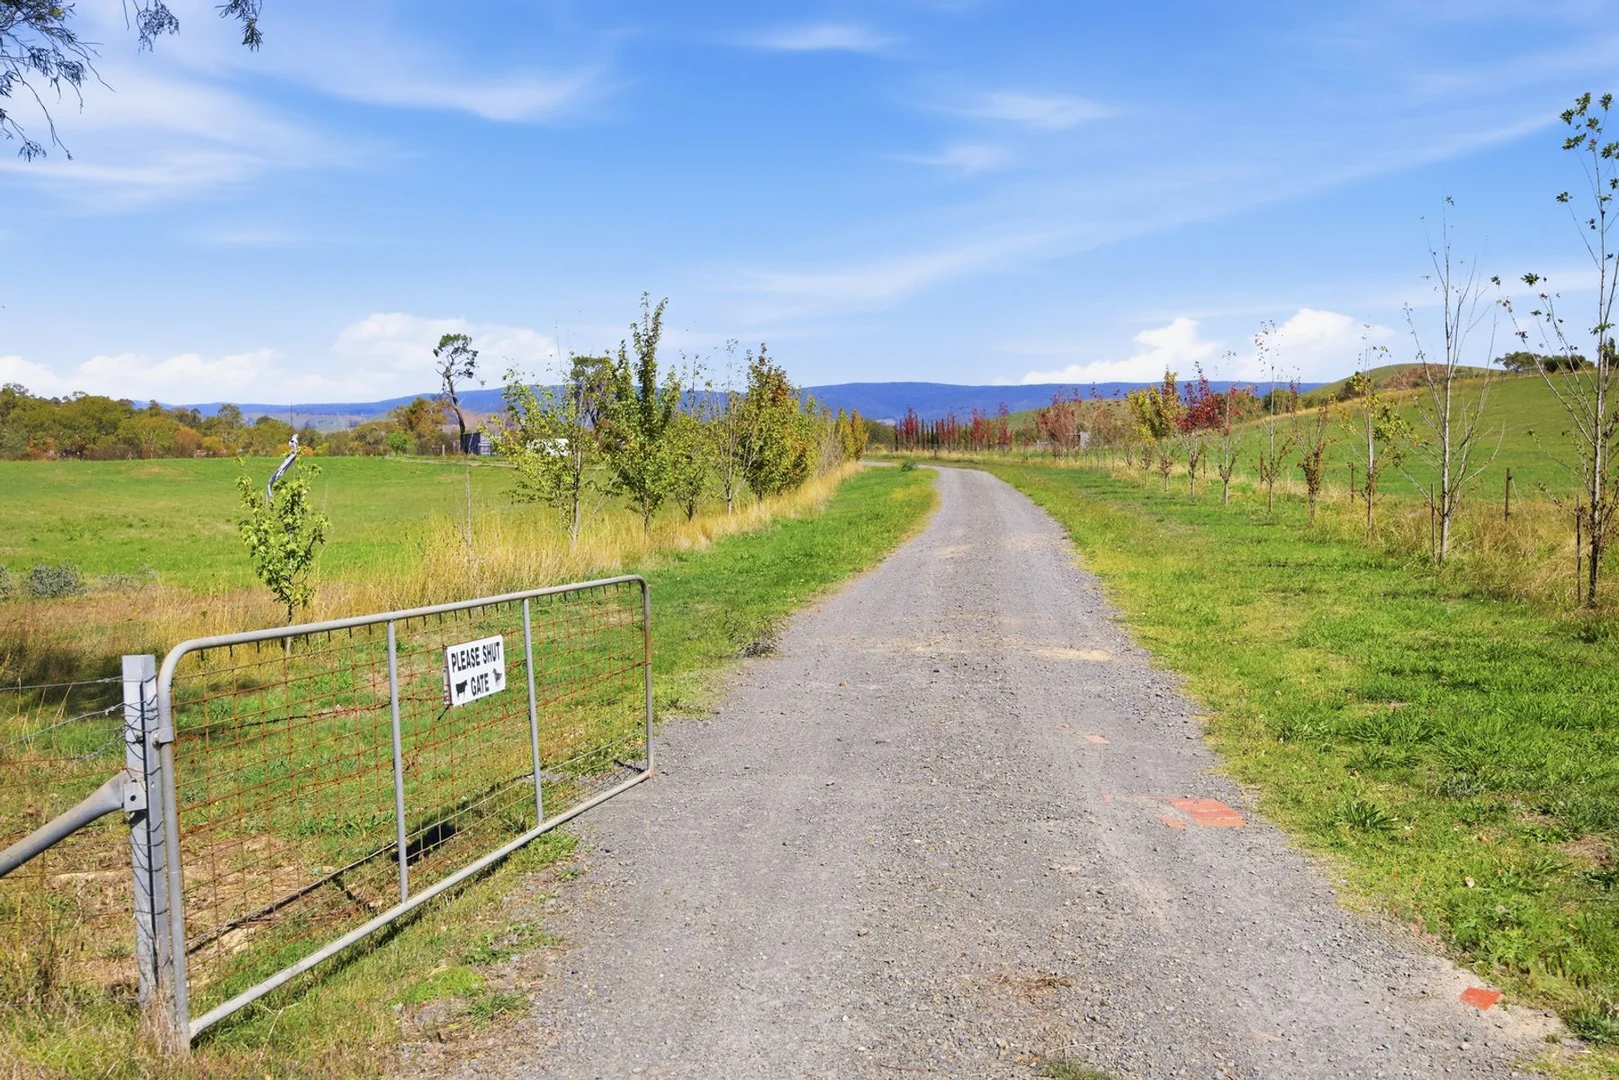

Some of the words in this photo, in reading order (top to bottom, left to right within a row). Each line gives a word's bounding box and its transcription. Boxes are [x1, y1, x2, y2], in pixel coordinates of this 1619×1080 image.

[451, 646, 481, 673] PLEASE
[482, 641, 500, 664] SHUT
[470, 672, 490, 697] GATE
